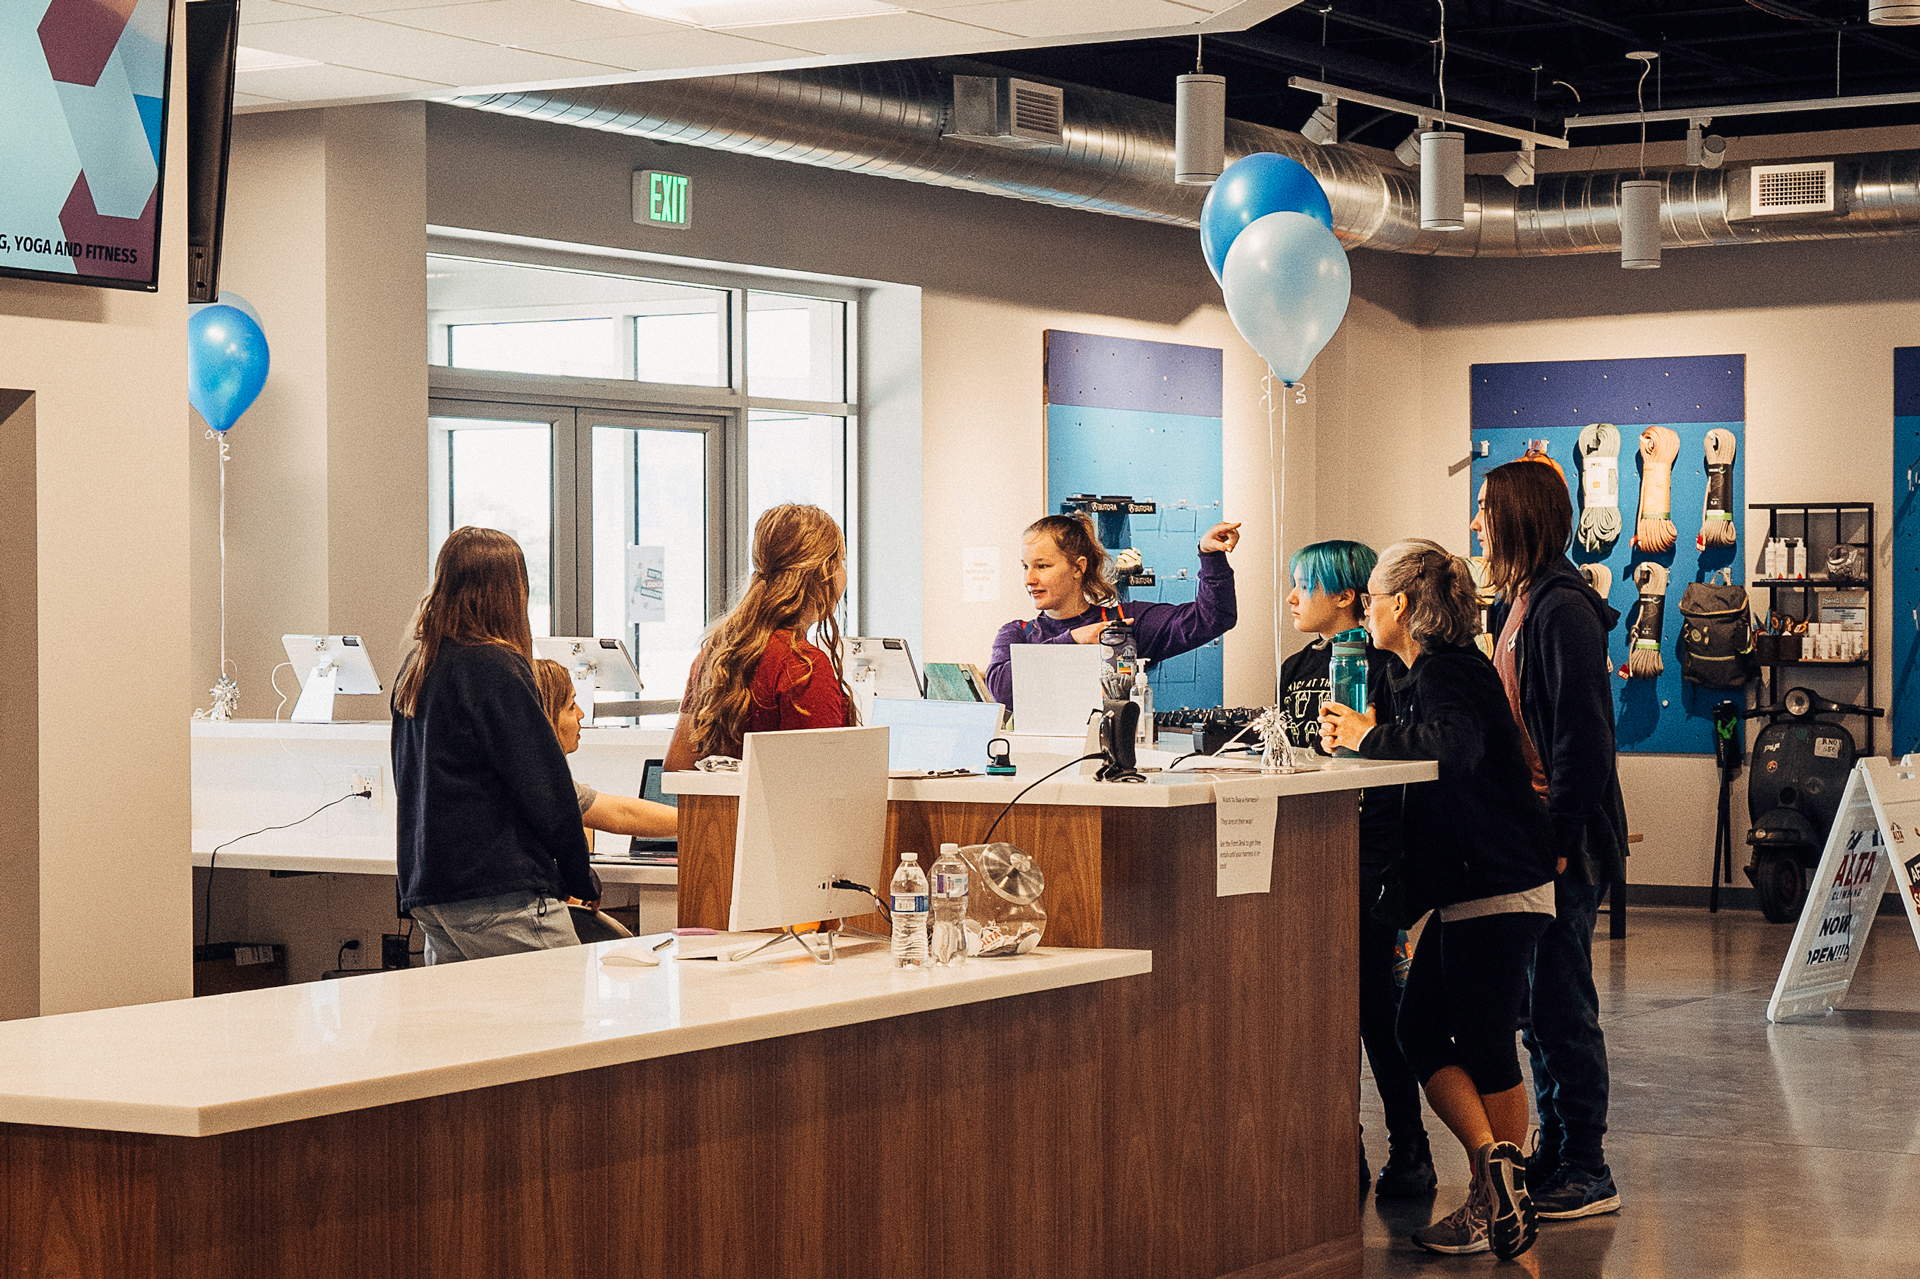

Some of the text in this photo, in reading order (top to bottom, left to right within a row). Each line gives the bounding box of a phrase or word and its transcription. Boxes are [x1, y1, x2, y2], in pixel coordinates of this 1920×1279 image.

[650, 172, 688, 224] EXIT
[14, 235, 52, 254] YOGA
[54, 240, 83, 258] AND
[85, 243, 138, 264] FITNESS
[1305, 678, 1318, 688] AT
[1320, 678, 1330, 688] TH
[1832, 851, 1876, 888] ALTA
[1831, 888, 1862, 901] CLIMBING
[1818, 914, 1853, 937] NOW
[981, 931, 1001, 949] ALTA
